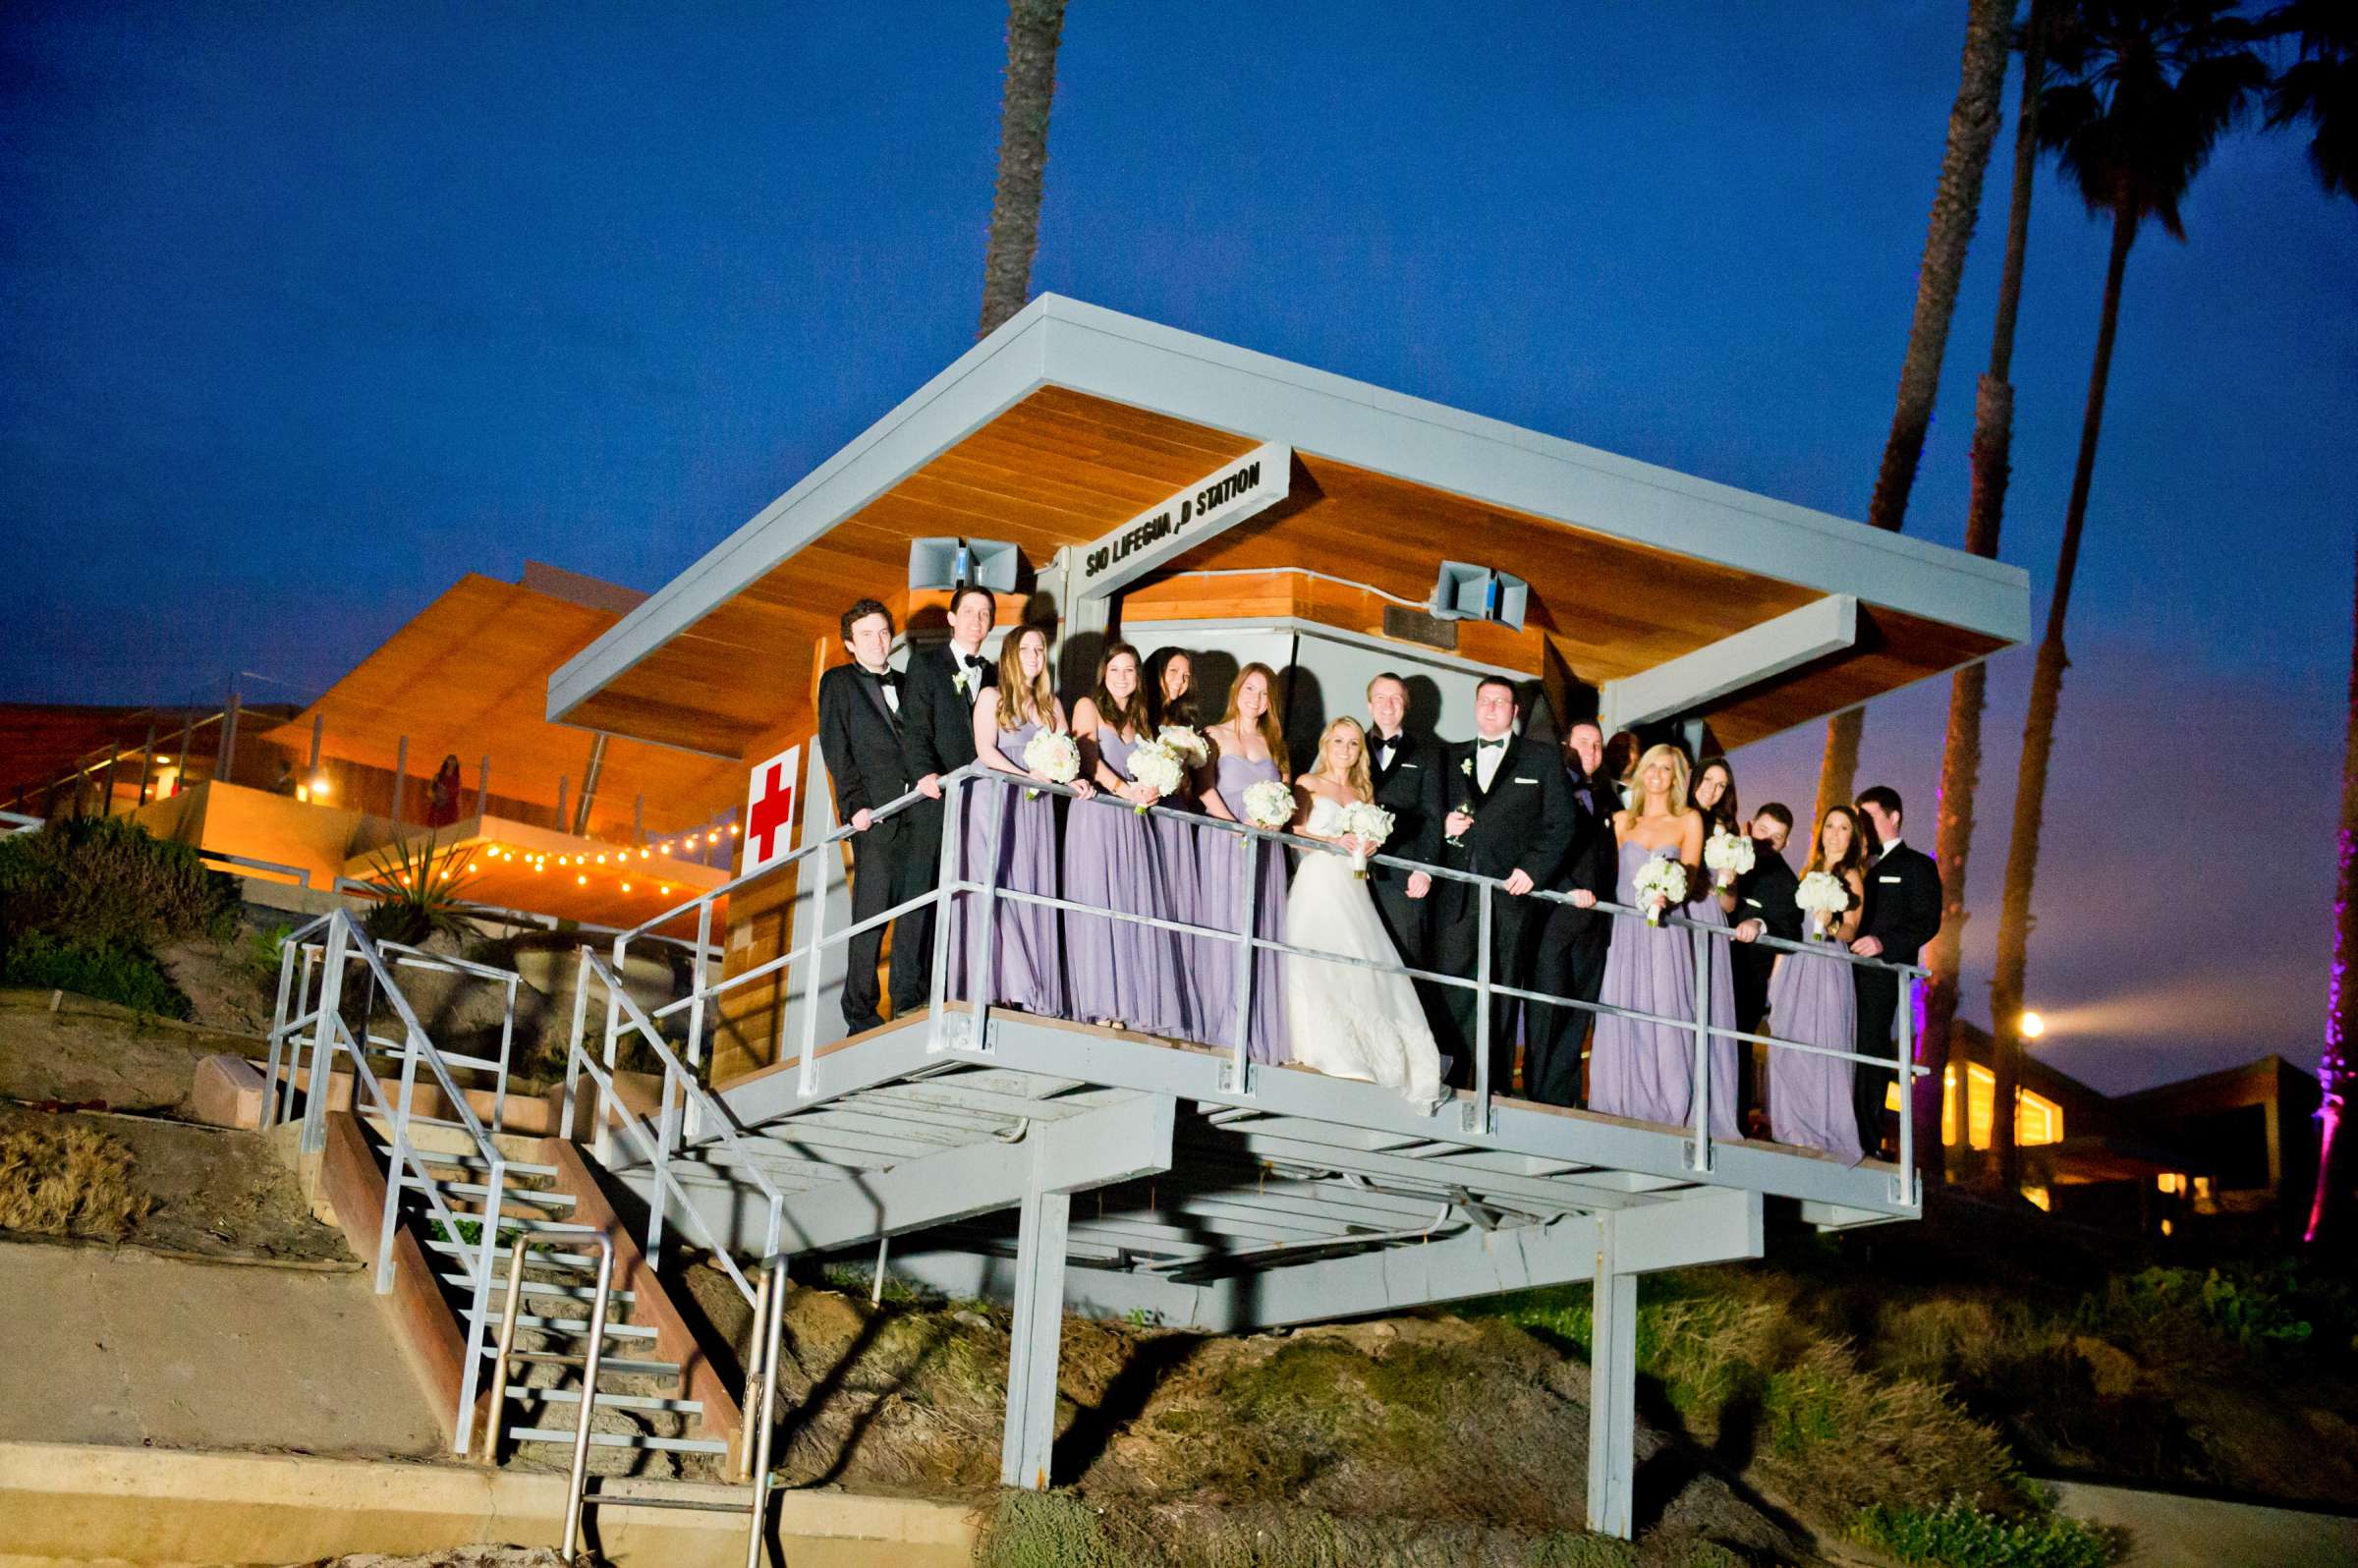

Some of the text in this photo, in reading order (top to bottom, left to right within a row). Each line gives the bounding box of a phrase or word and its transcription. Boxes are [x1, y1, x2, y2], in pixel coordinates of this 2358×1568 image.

[1086, 461, 1261, 578] SIO LIFEGUAD STATION
